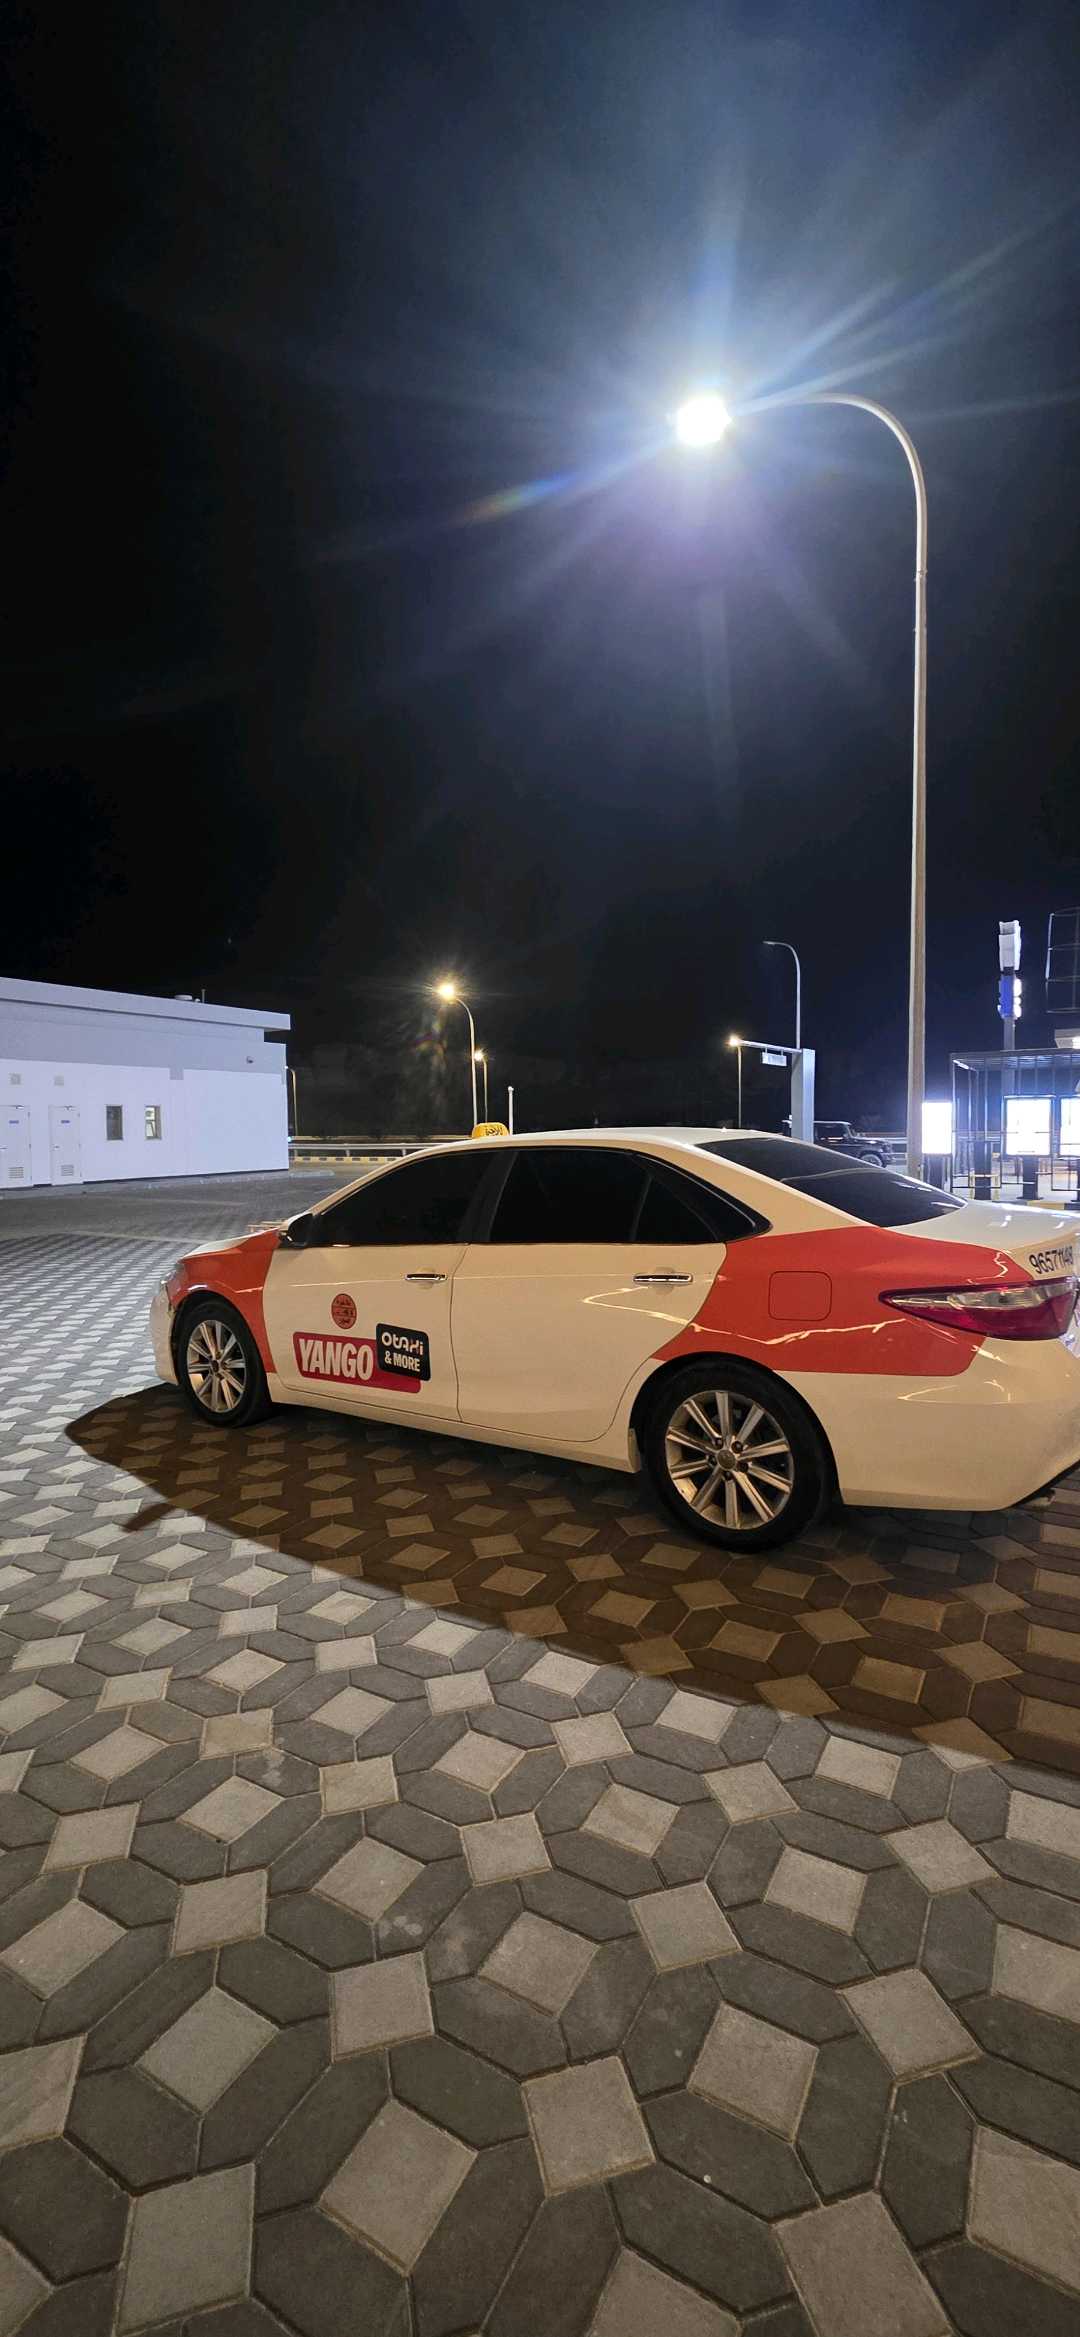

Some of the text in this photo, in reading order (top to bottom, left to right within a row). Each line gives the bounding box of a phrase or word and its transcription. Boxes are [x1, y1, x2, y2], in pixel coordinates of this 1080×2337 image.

[298, 1338, 373, 1380] YANGO
[384, 1351, 421, 1372] & MORE
